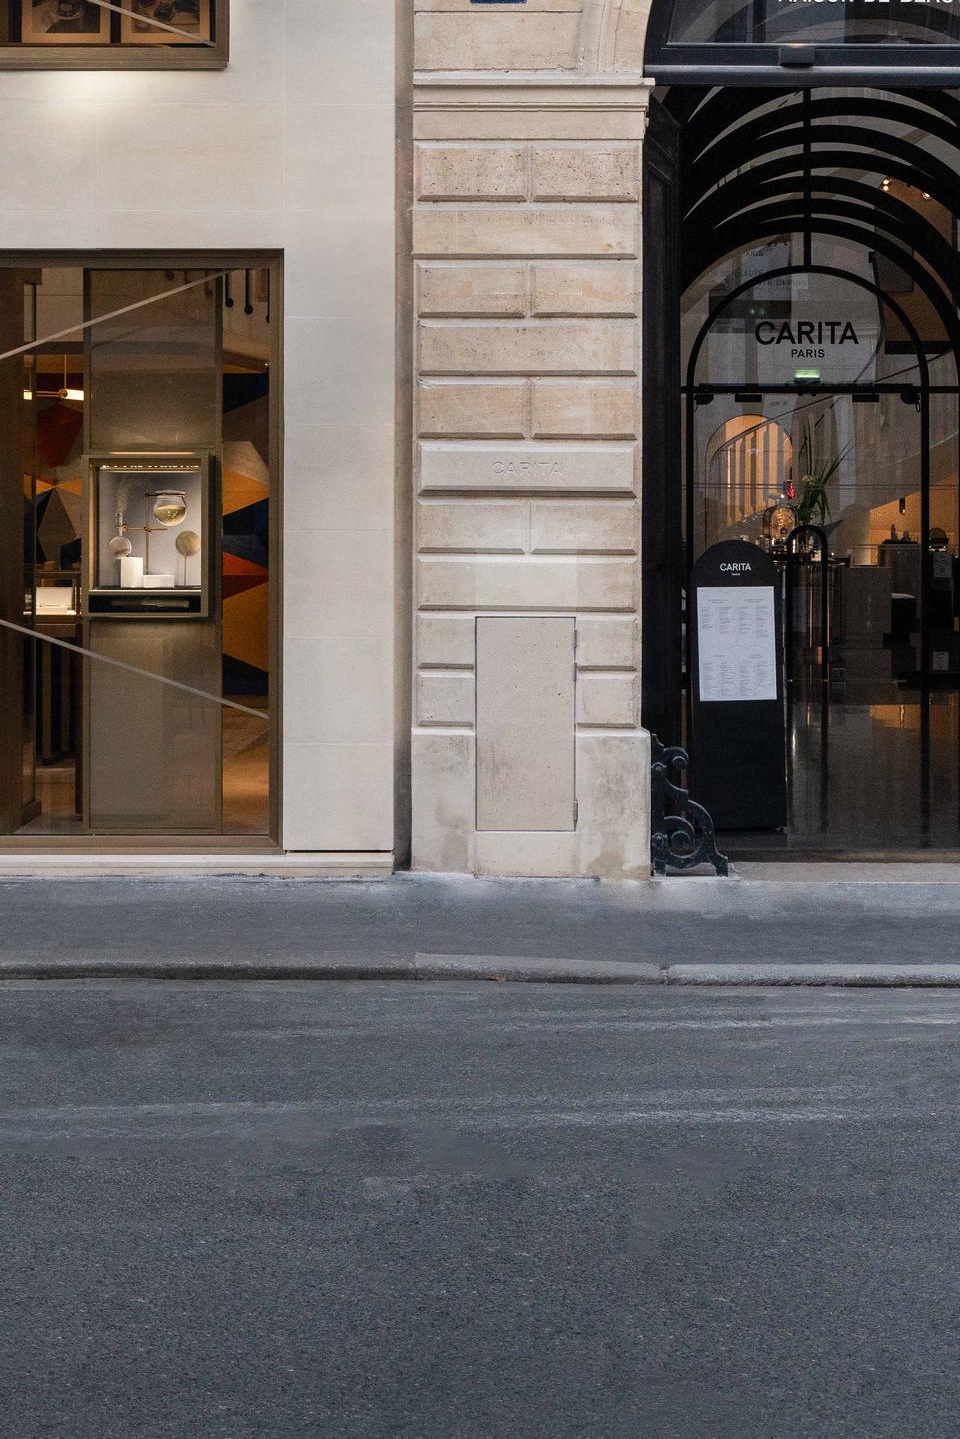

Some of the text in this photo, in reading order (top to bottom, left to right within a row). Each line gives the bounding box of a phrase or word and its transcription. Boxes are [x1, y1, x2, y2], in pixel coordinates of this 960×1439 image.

[754, 320, 860, 346] CARITA
[790, 348, 826, 359] PARIS
[719, 562, 752, 572] CARITA
